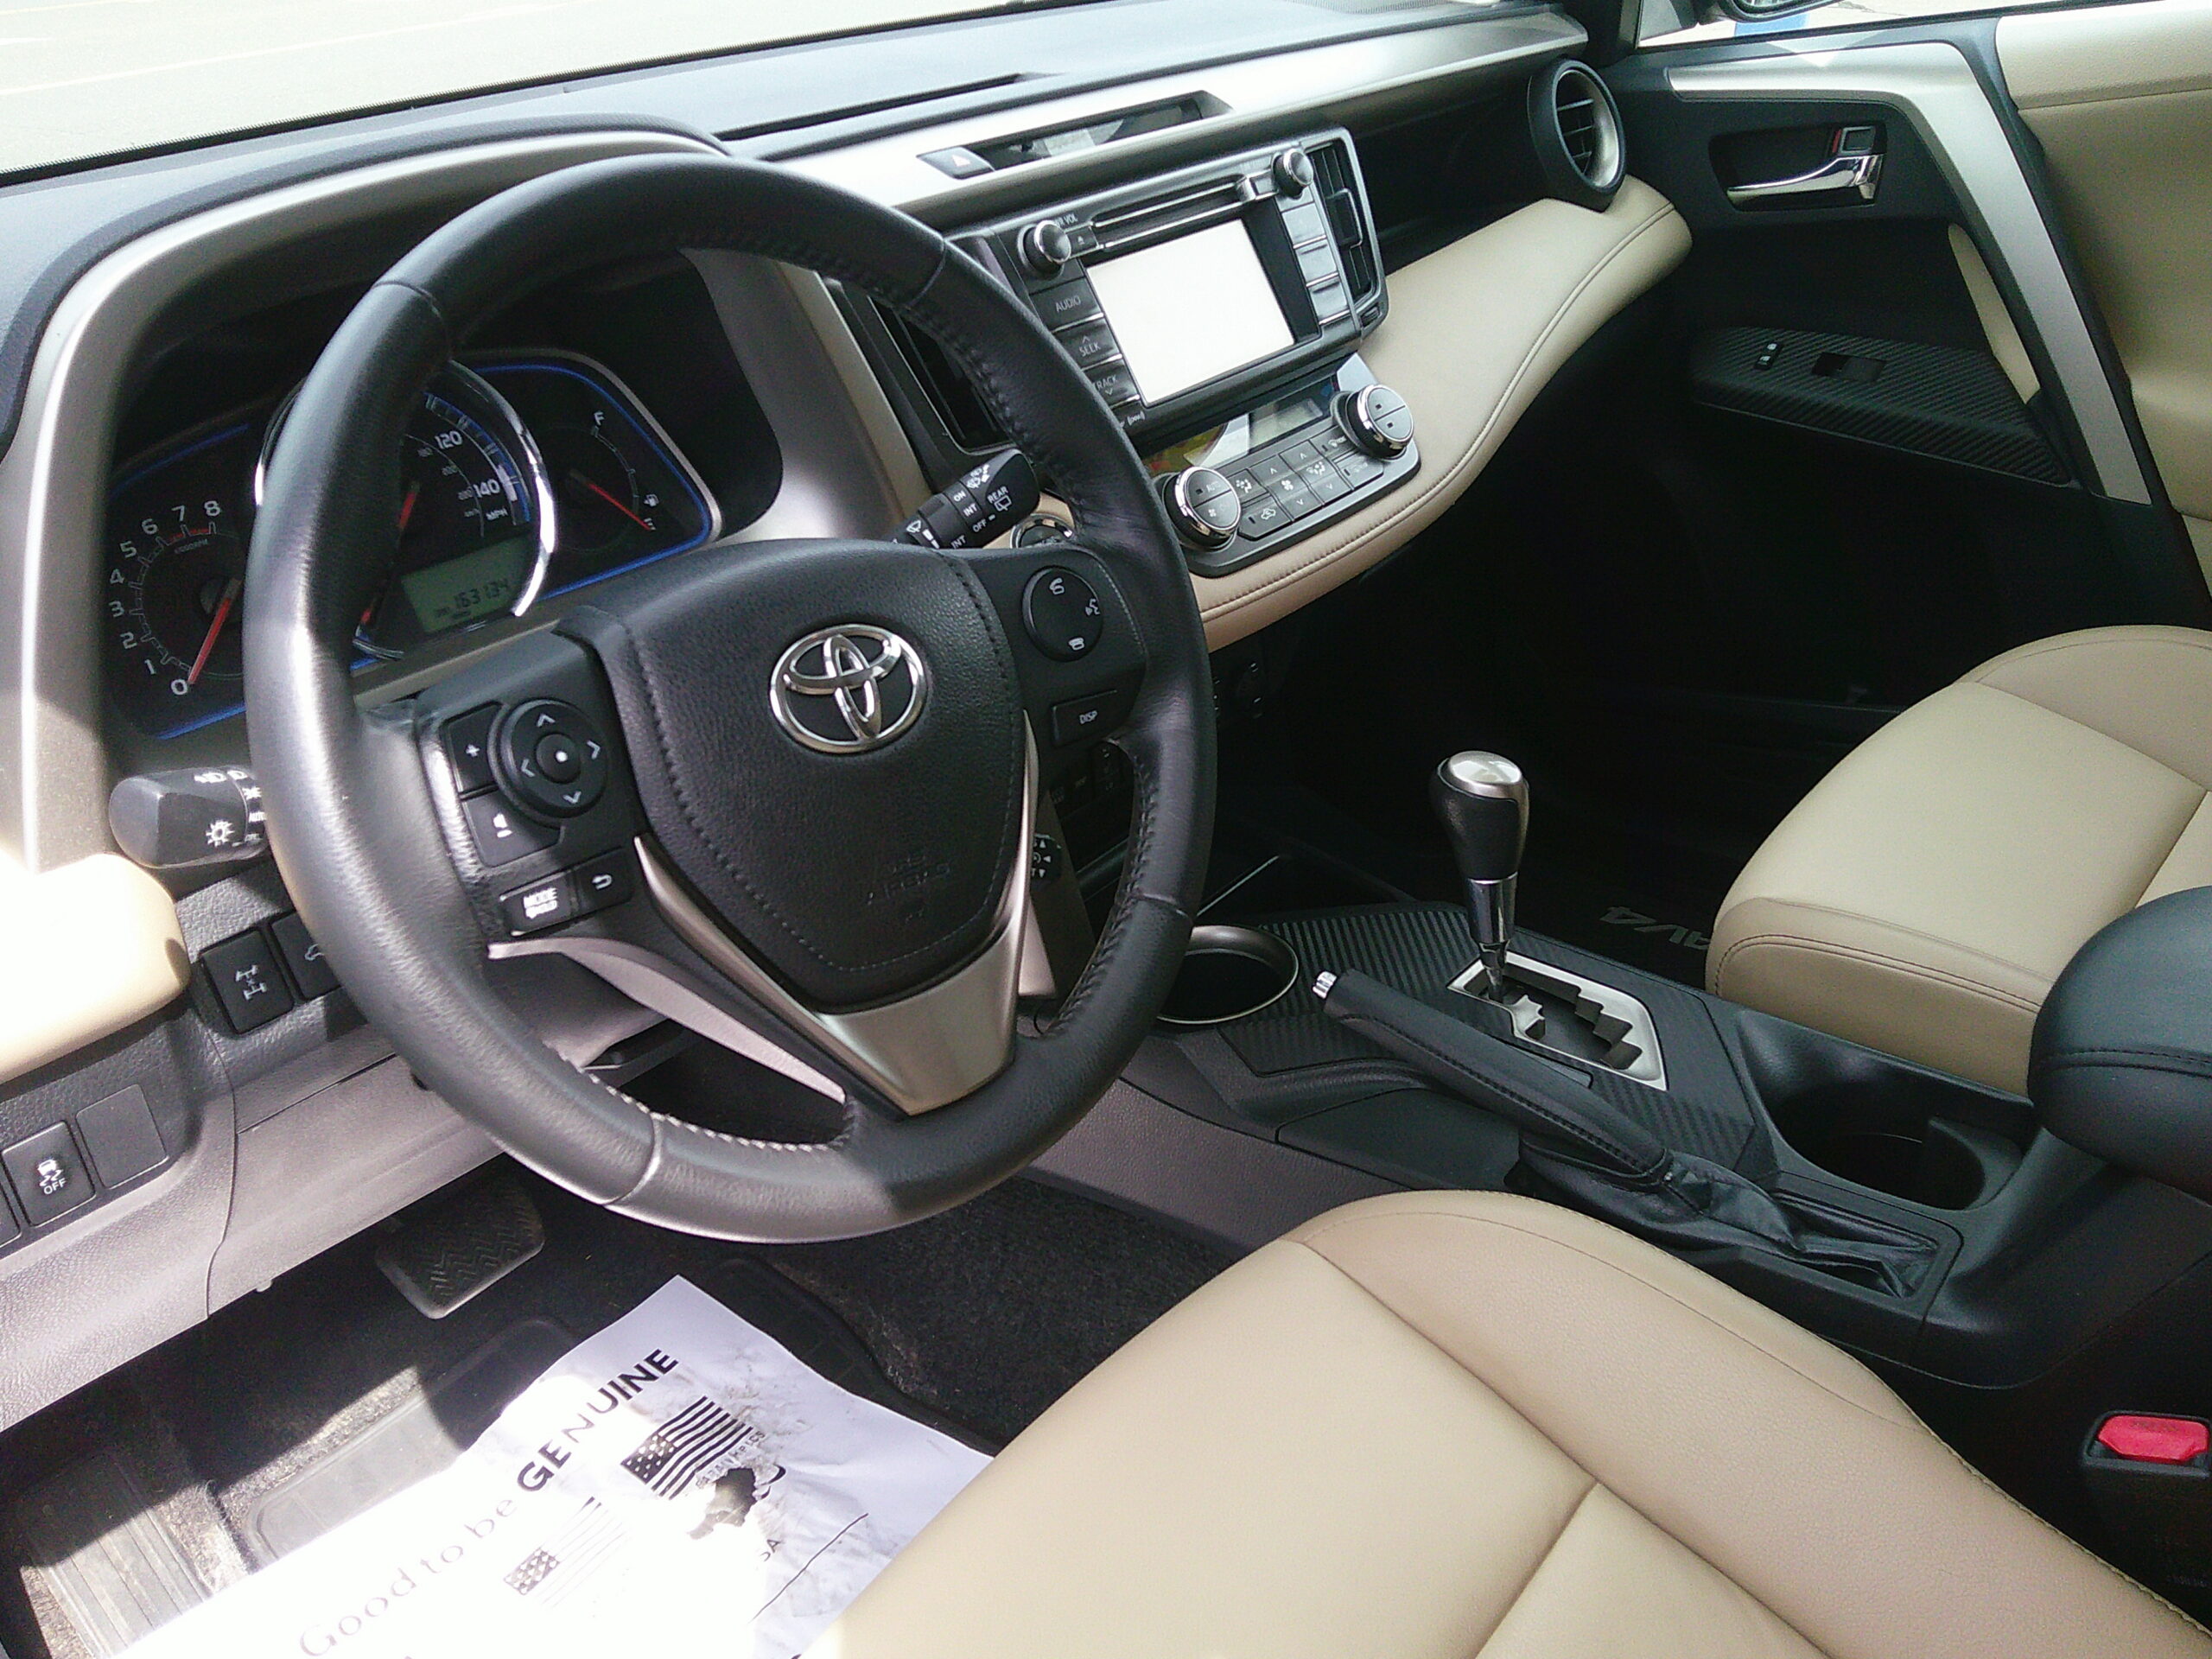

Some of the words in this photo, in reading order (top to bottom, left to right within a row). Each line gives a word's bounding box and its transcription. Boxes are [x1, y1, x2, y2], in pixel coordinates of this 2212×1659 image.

[1056, 296, 1082, 313] AUDIO
[1079, 342, 1101, 357] SEEK
[594, 411, 604, 425] F
[435, 431, 462, 448] 120
[473, 479, 500, 498] 140
[953, 490, 966, 502] ON
[987, 486, 1009, 504] REAR
[171, 505, 185, 522] 7
[203, 500, 221, 517] 8
[486, 508, 508, 520] MPH
[963, 503, 978, 518] INT
[141, 518, 157, 535] 6
[972, 518, 988, 533] OFF
[119, 540, 137, 558] 5
[950, 535, 966, 550] INT
[110, 569, 125, 585] 4
[109, 601, 124, 617] 3
[120, 632, 138, 650] 2
[143, 658, 156, 675] 1
[170, 678, 188, 696] 0
[1079, 710, 1097, 725] DISP
[1599, 906, 1711, 950] AV4
[43, 1178, 66, 1194] OFF
[299, 1567, 416, 1657] Good
[419, 1545, 464, 1574] to
[463, 1498, 516, 1540] be
[517, 1349, 679, 1491] GENUINE
